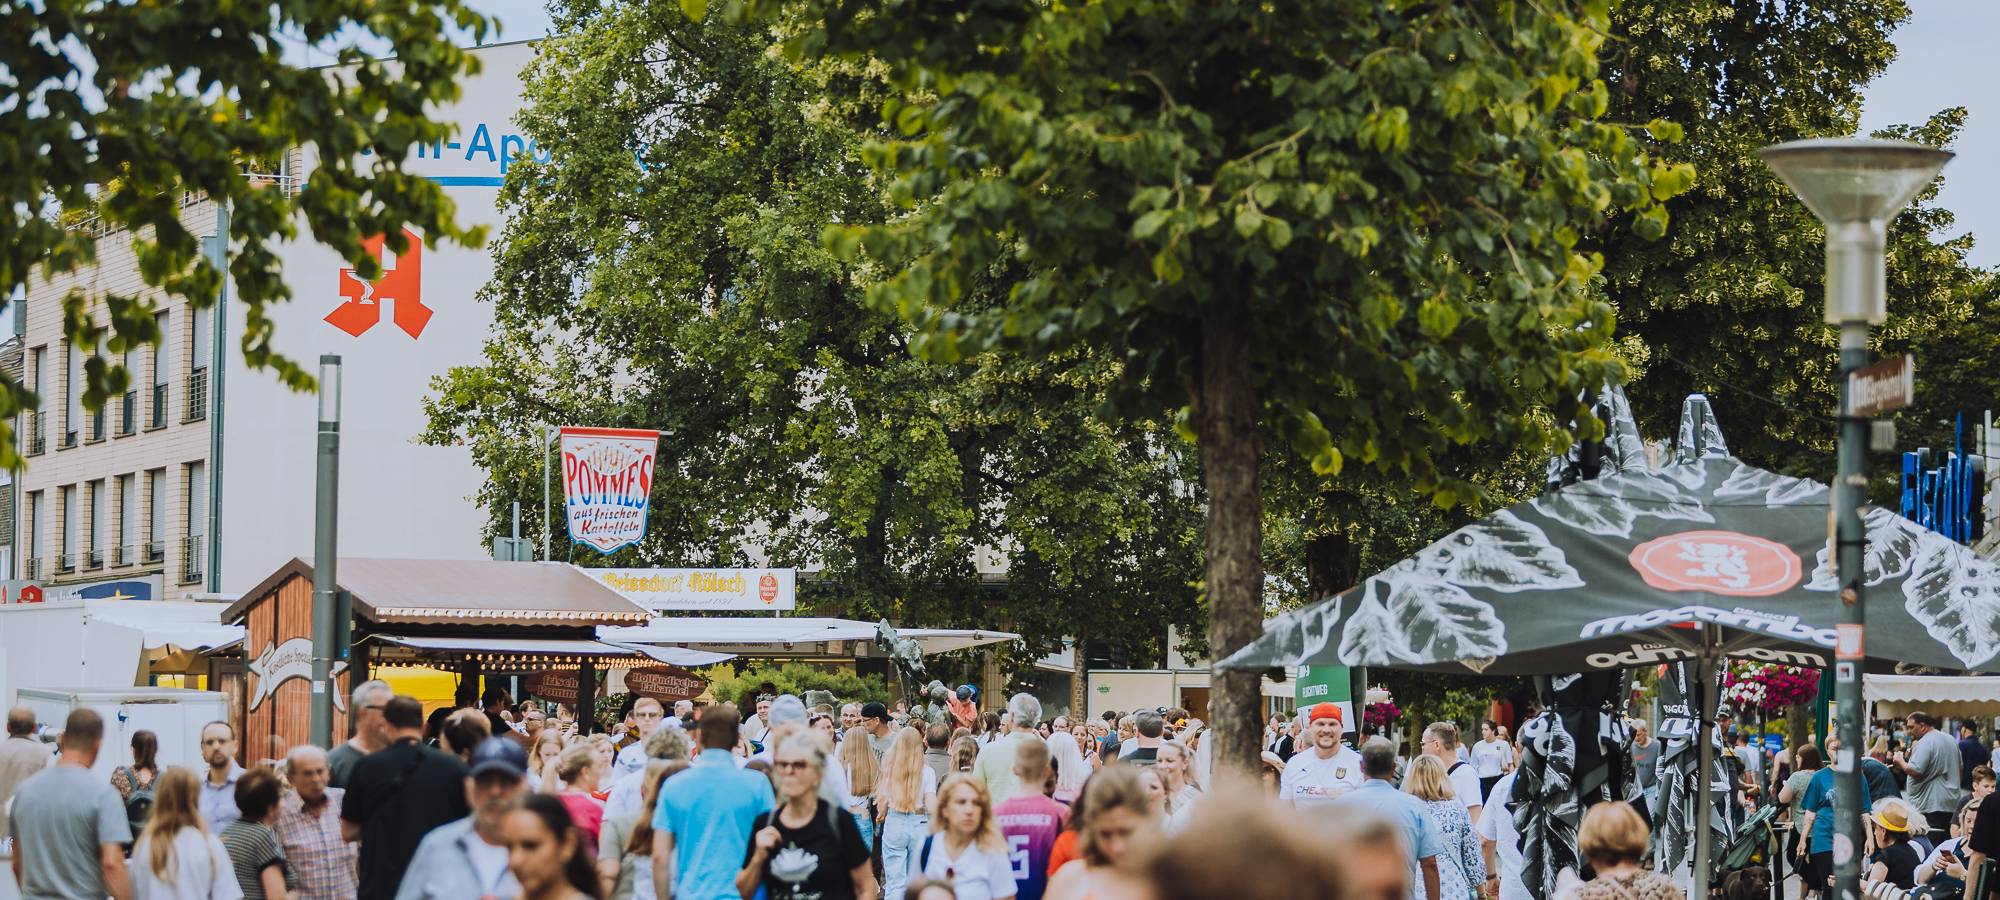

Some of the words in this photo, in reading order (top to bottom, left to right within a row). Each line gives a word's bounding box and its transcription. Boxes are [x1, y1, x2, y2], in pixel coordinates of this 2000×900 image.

[565, 452, 652, 509] POMMES
[574, 508, 592, 520] aus
[594, 507, 638, 521] frischen
[581, 520, 640, 535] Kartoffeln
[543, 674, 579, 688] frisch
[632, 671, 699, 688] Holländische
[536, 685, 578, 699] Pomm
[1007, 834, 1030, 880] 5
